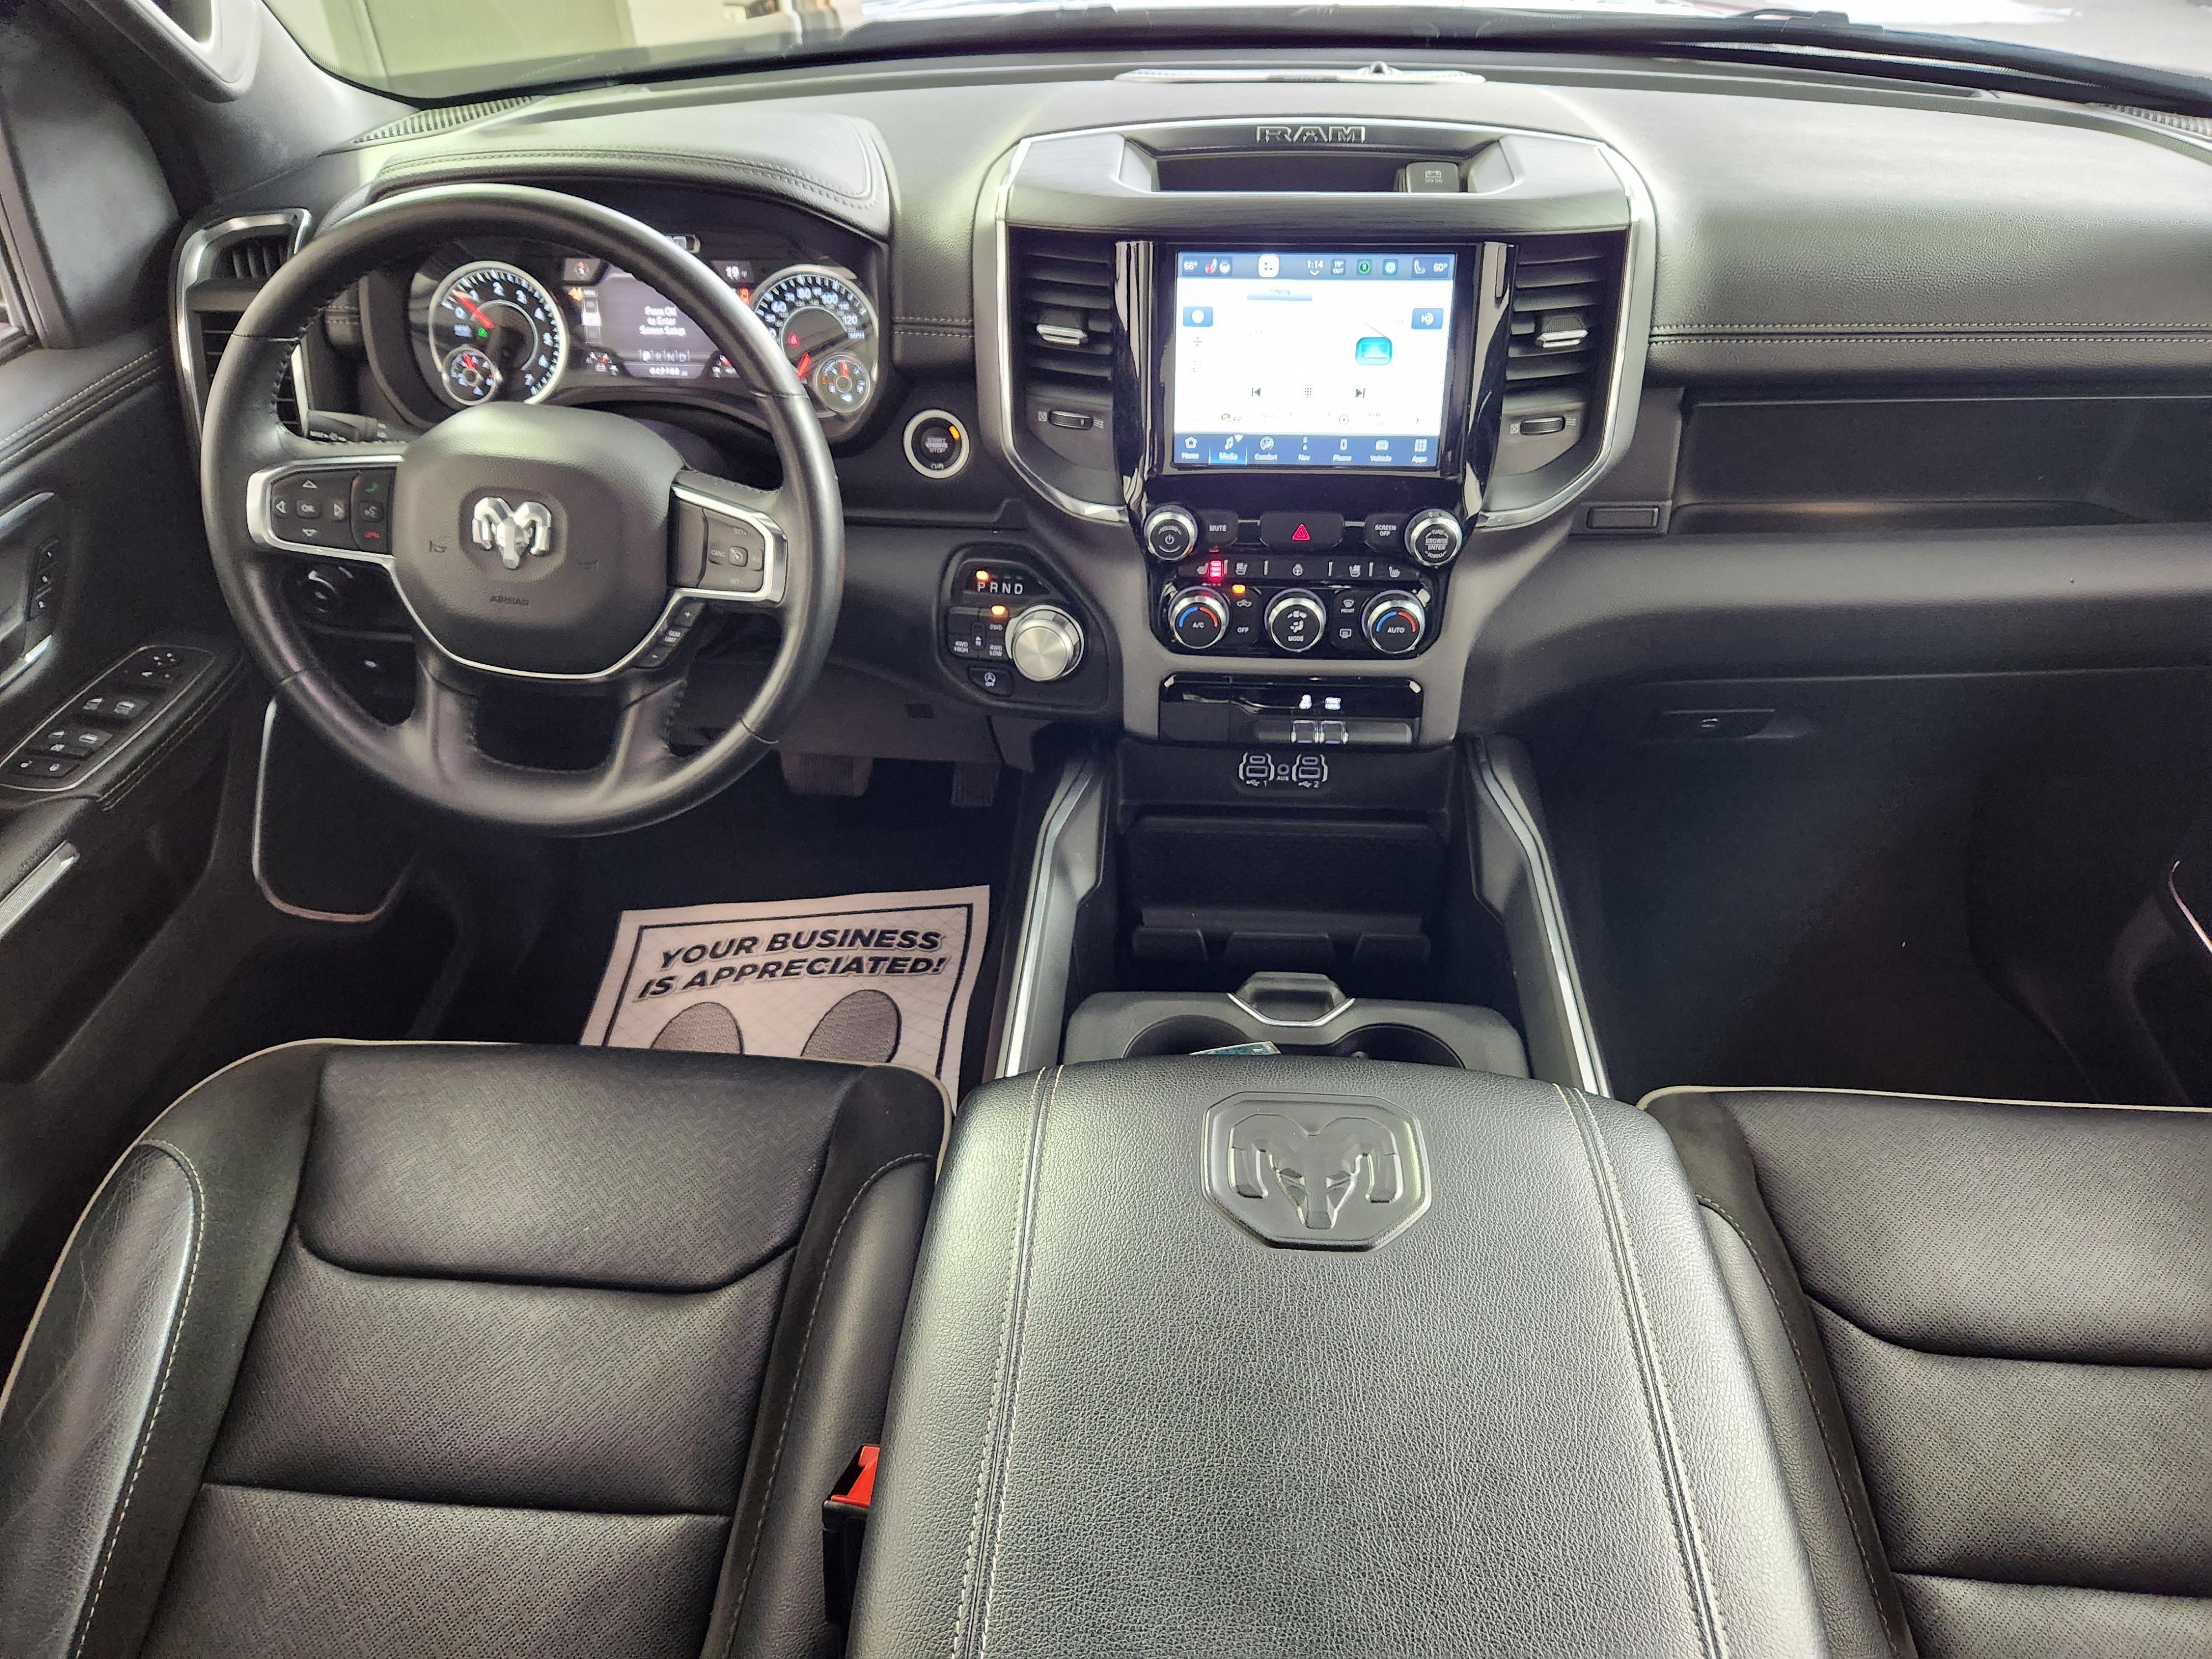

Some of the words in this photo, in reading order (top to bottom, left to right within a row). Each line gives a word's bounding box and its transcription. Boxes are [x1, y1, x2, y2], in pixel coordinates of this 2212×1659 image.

[1256, 126, 1365, 143] RAM
[1307, 260, 1323, 269] 1:14
[784, 292, 795, 302] 70
[796, 286, 811, 299] 80
[820, 292, 838, 304] 100
[771, 300, 786, 312] 60
[838, 301, 849, 311] 110
[455, 306, 466, 320] 0
[492, 281, 504, 296] 2
[515, 289, 528, 304] 3
[534, 307, 545, 321] 4
[543, 332, 553, 347] 5
[843, 313, 858, 325] 120
[848, 331, 865, 340] MPH
[667, 353, 675, 362] N
[679, 353, 686, 362] D
[1219, 452, 1238, 460] Media
[301, 504, 315, 512] OK
[977, 582, 985, 592] P
[990, 582, 998, 593] R
[1002, 583, 1011, 594] N
[1014, 583, 1023, 594] D
[661, 935, 758, 969] YOUR
[767, 928, 942, 952] BUSINESS
[637, 977, 675, 999] IS
[681, 956, 946, 989] APPRECIATED!
